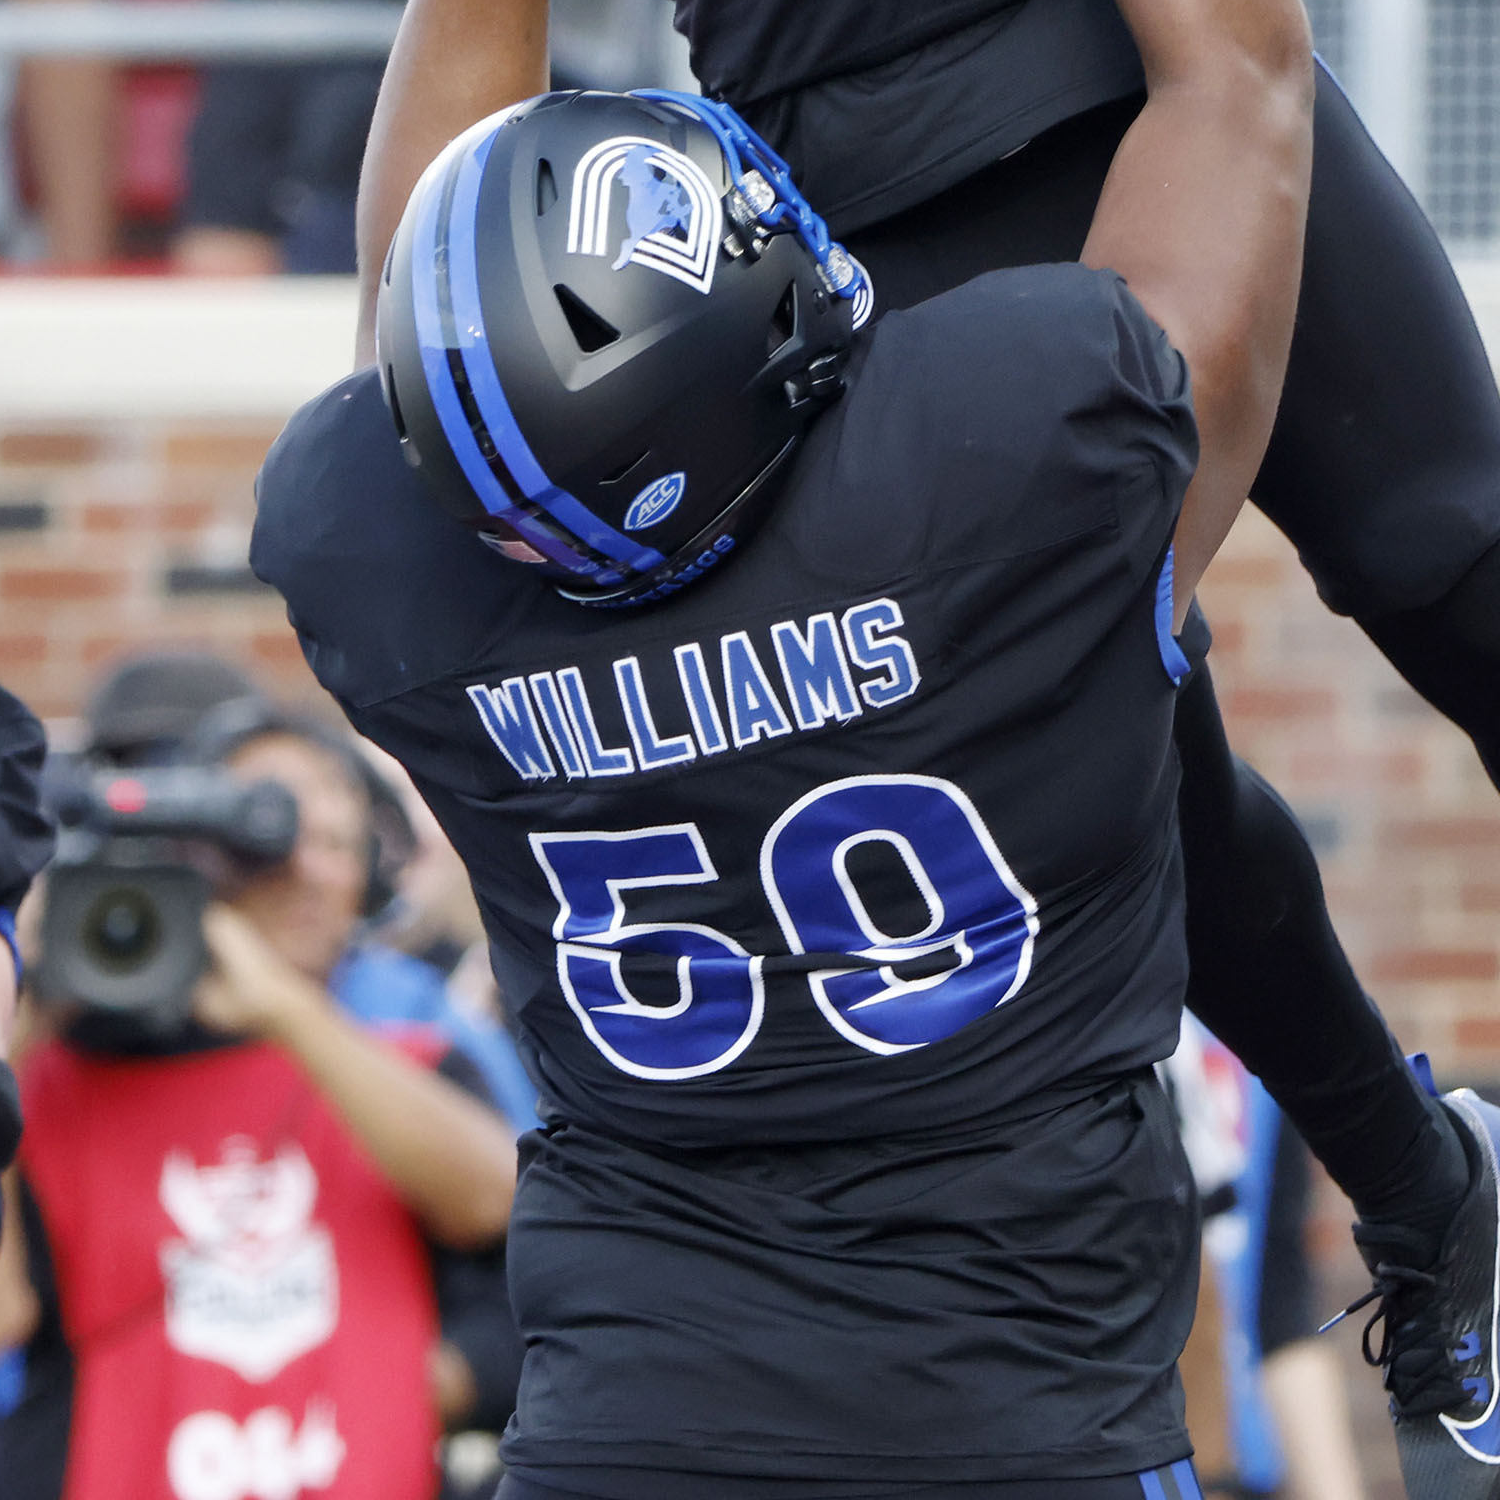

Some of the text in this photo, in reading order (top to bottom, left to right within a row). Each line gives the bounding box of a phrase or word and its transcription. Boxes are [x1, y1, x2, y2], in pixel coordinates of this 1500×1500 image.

[636, 477, 677, 522] ACC
[466, 596, 922, 781] WILLIAMS
[528, 773, 1040, 1082] 59
